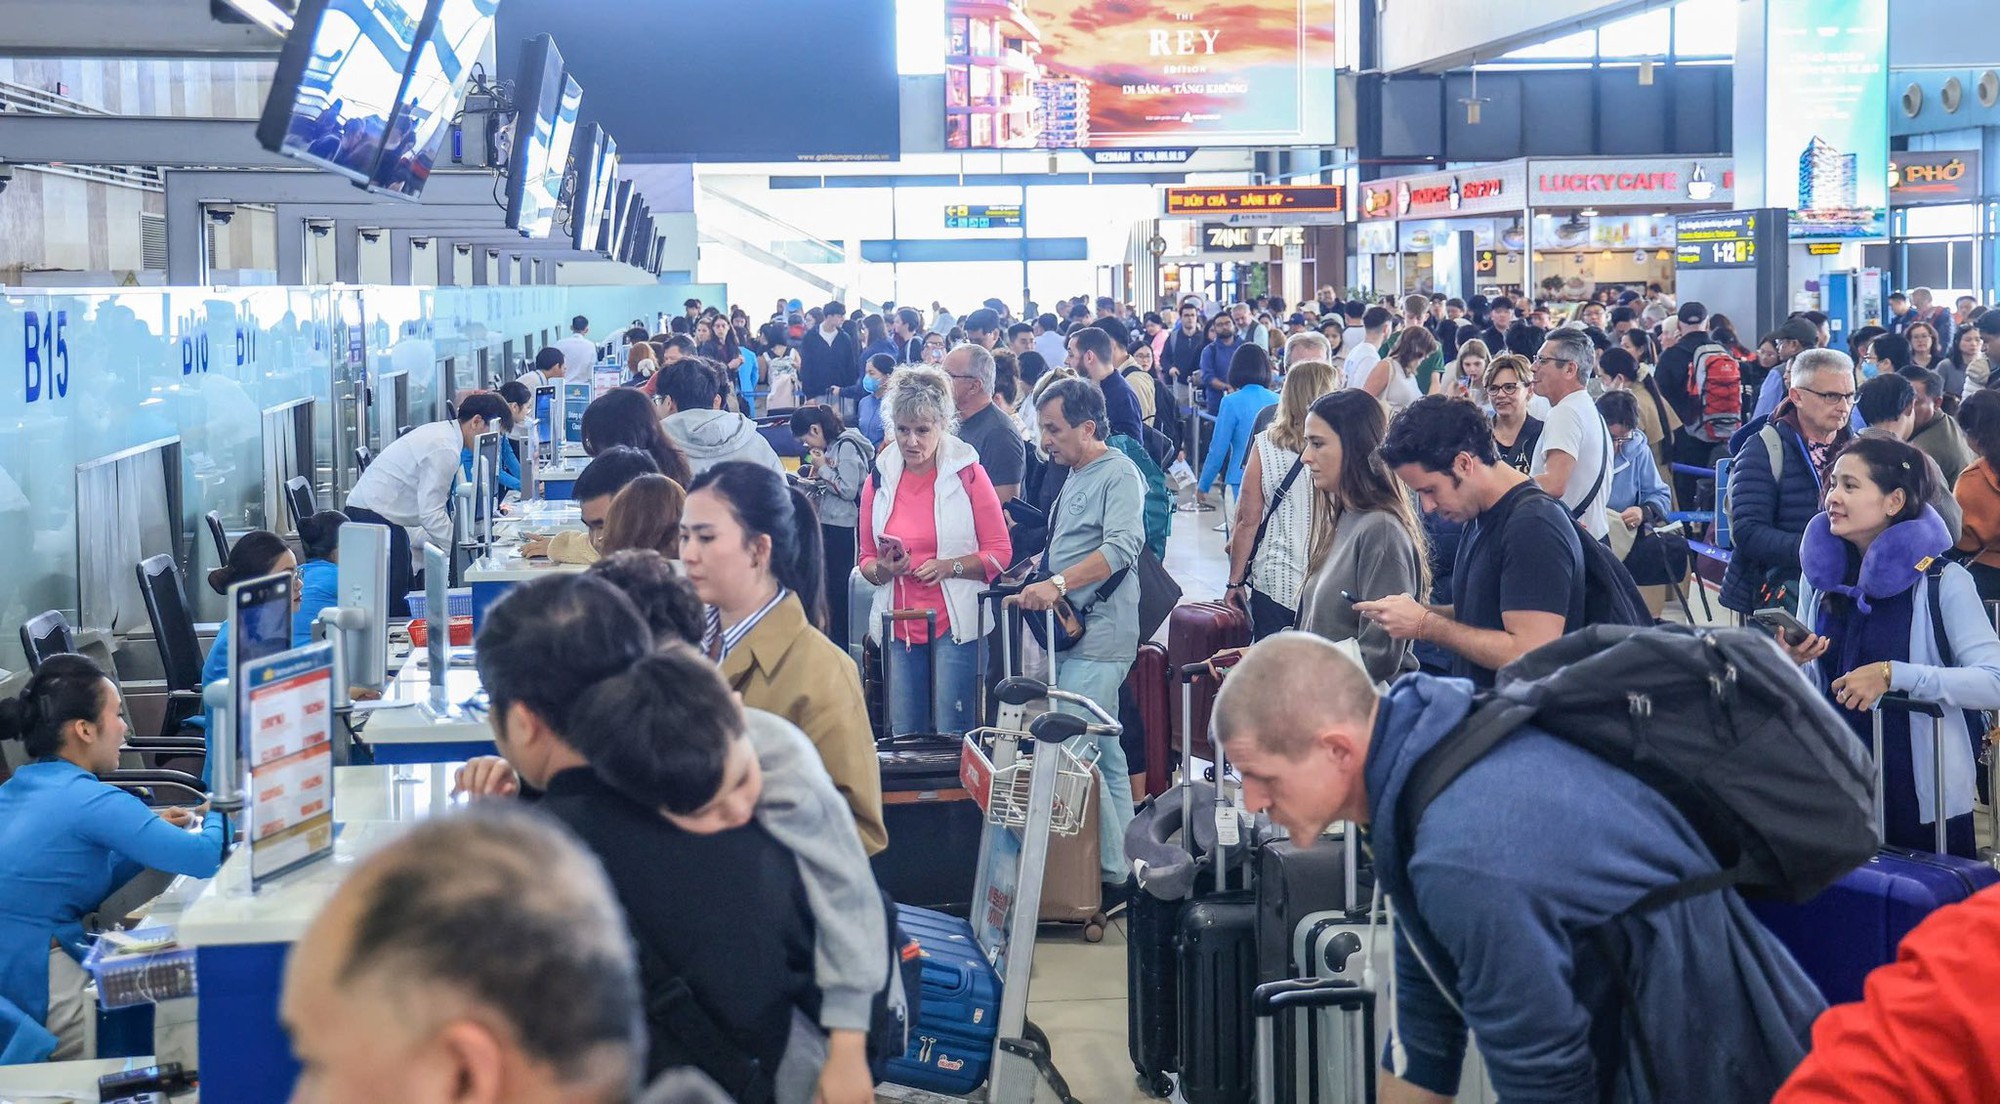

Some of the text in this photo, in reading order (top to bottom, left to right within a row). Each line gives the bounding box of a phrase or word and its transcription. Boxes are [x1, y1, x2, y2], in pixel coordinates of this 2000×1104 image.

[1150, 29, 1220, 55] REY
[1164, 66, 1206, 74] EDITION
[1905, 158, 1965, 183] PHỞ
[1539, 172, 1677, 192] LUCKY CAFE
[1257, 227, 1305, 247] CAFE
[24, 311, 69, 403] B15
